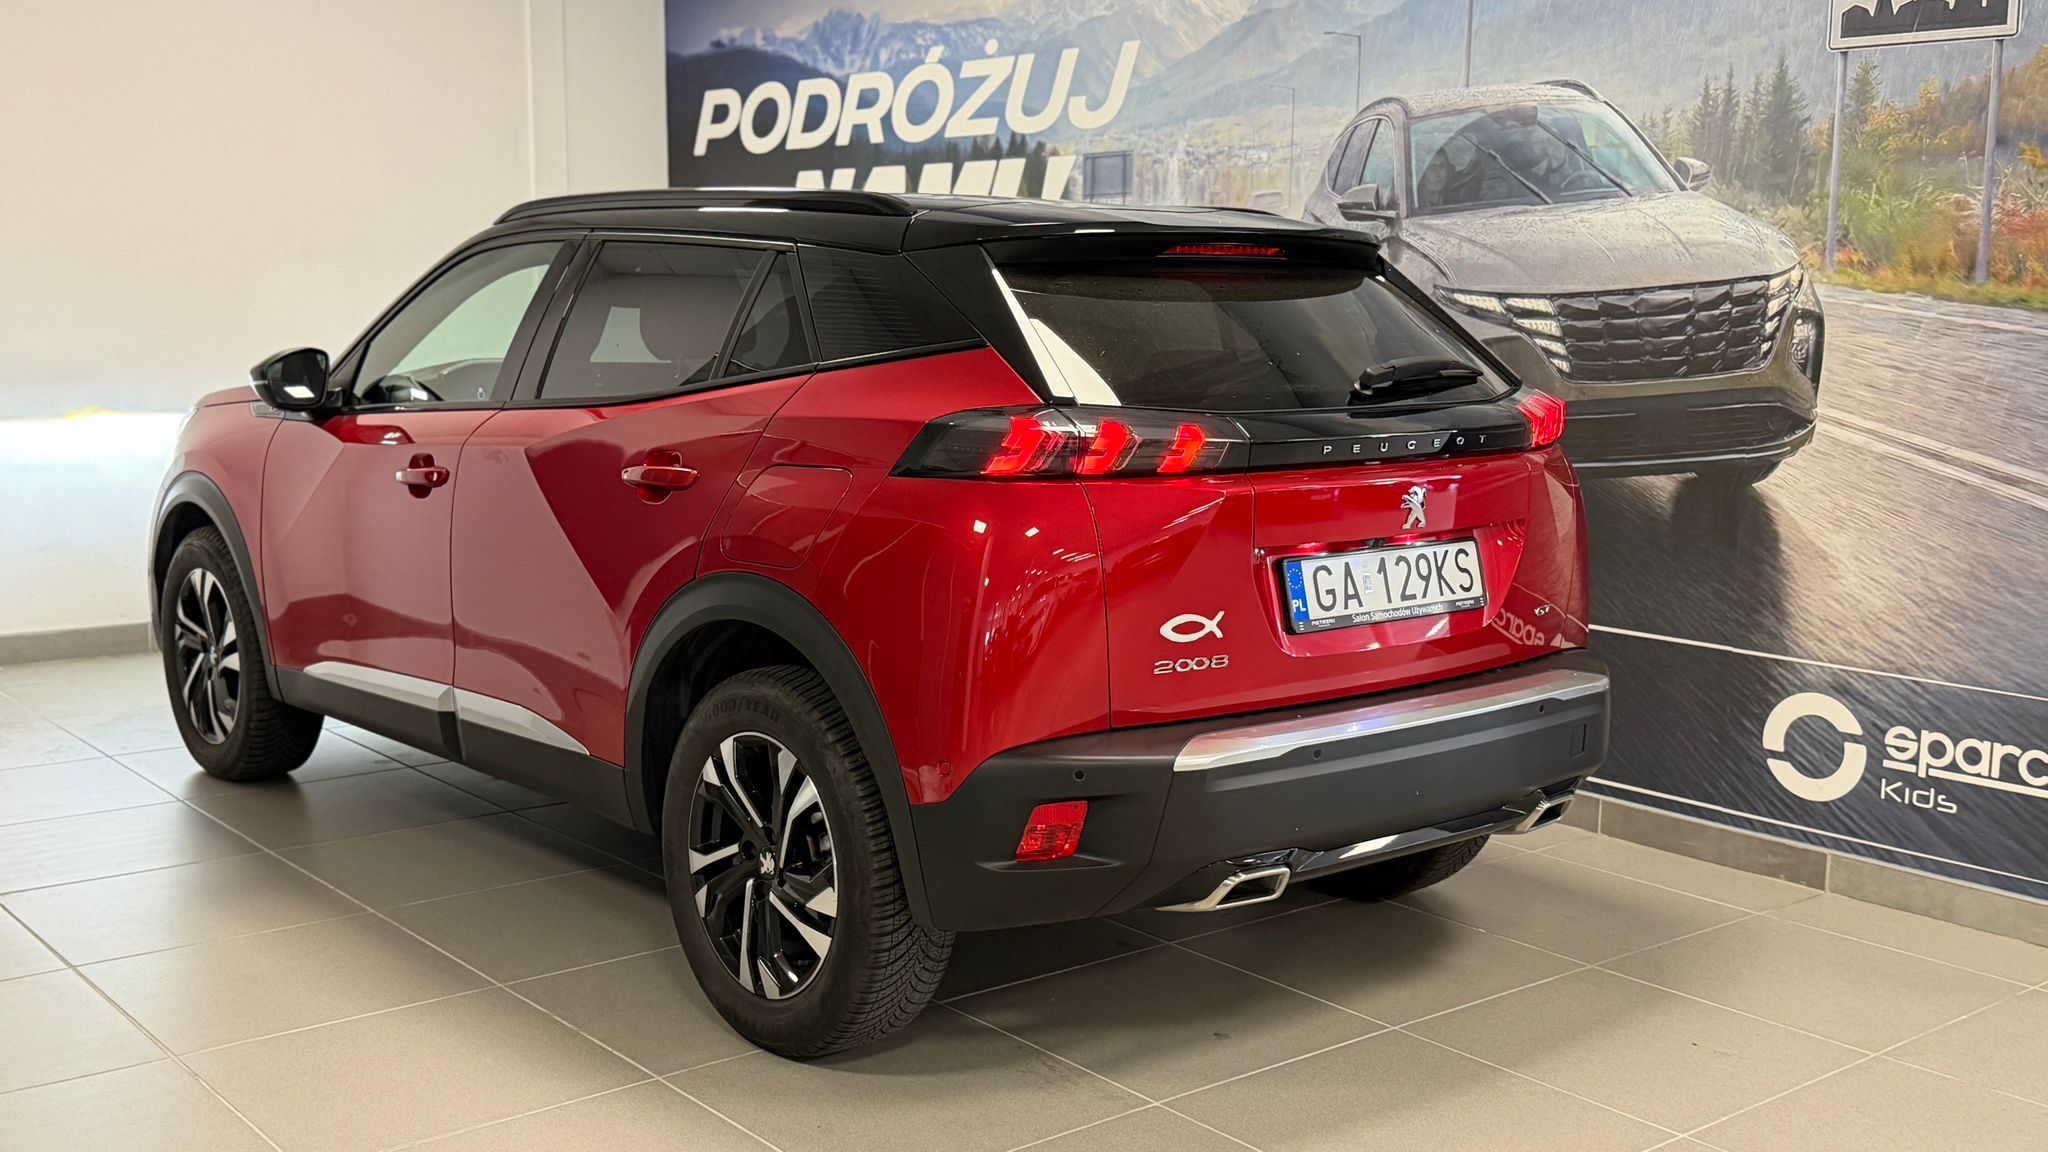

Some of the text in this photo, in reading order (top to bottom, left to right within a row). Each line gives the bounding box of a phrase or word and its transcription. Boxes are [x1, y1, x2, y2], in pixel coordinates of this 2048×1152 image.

[692, 38, 1140, 157] PODRÓŻUJ
[1322, 434, 1487, 455] PEUGEOT
[1312, 548, 1474, 612] GA 129KS
[1292, 599, 1307, 613] PL
[1352, 613, 1370, 623] Salon
[1370, 606, 1411, 621] Samochodów
[1153, 654, 1229, 675] 2008
[1880, 778, 1958, 815] Kids
